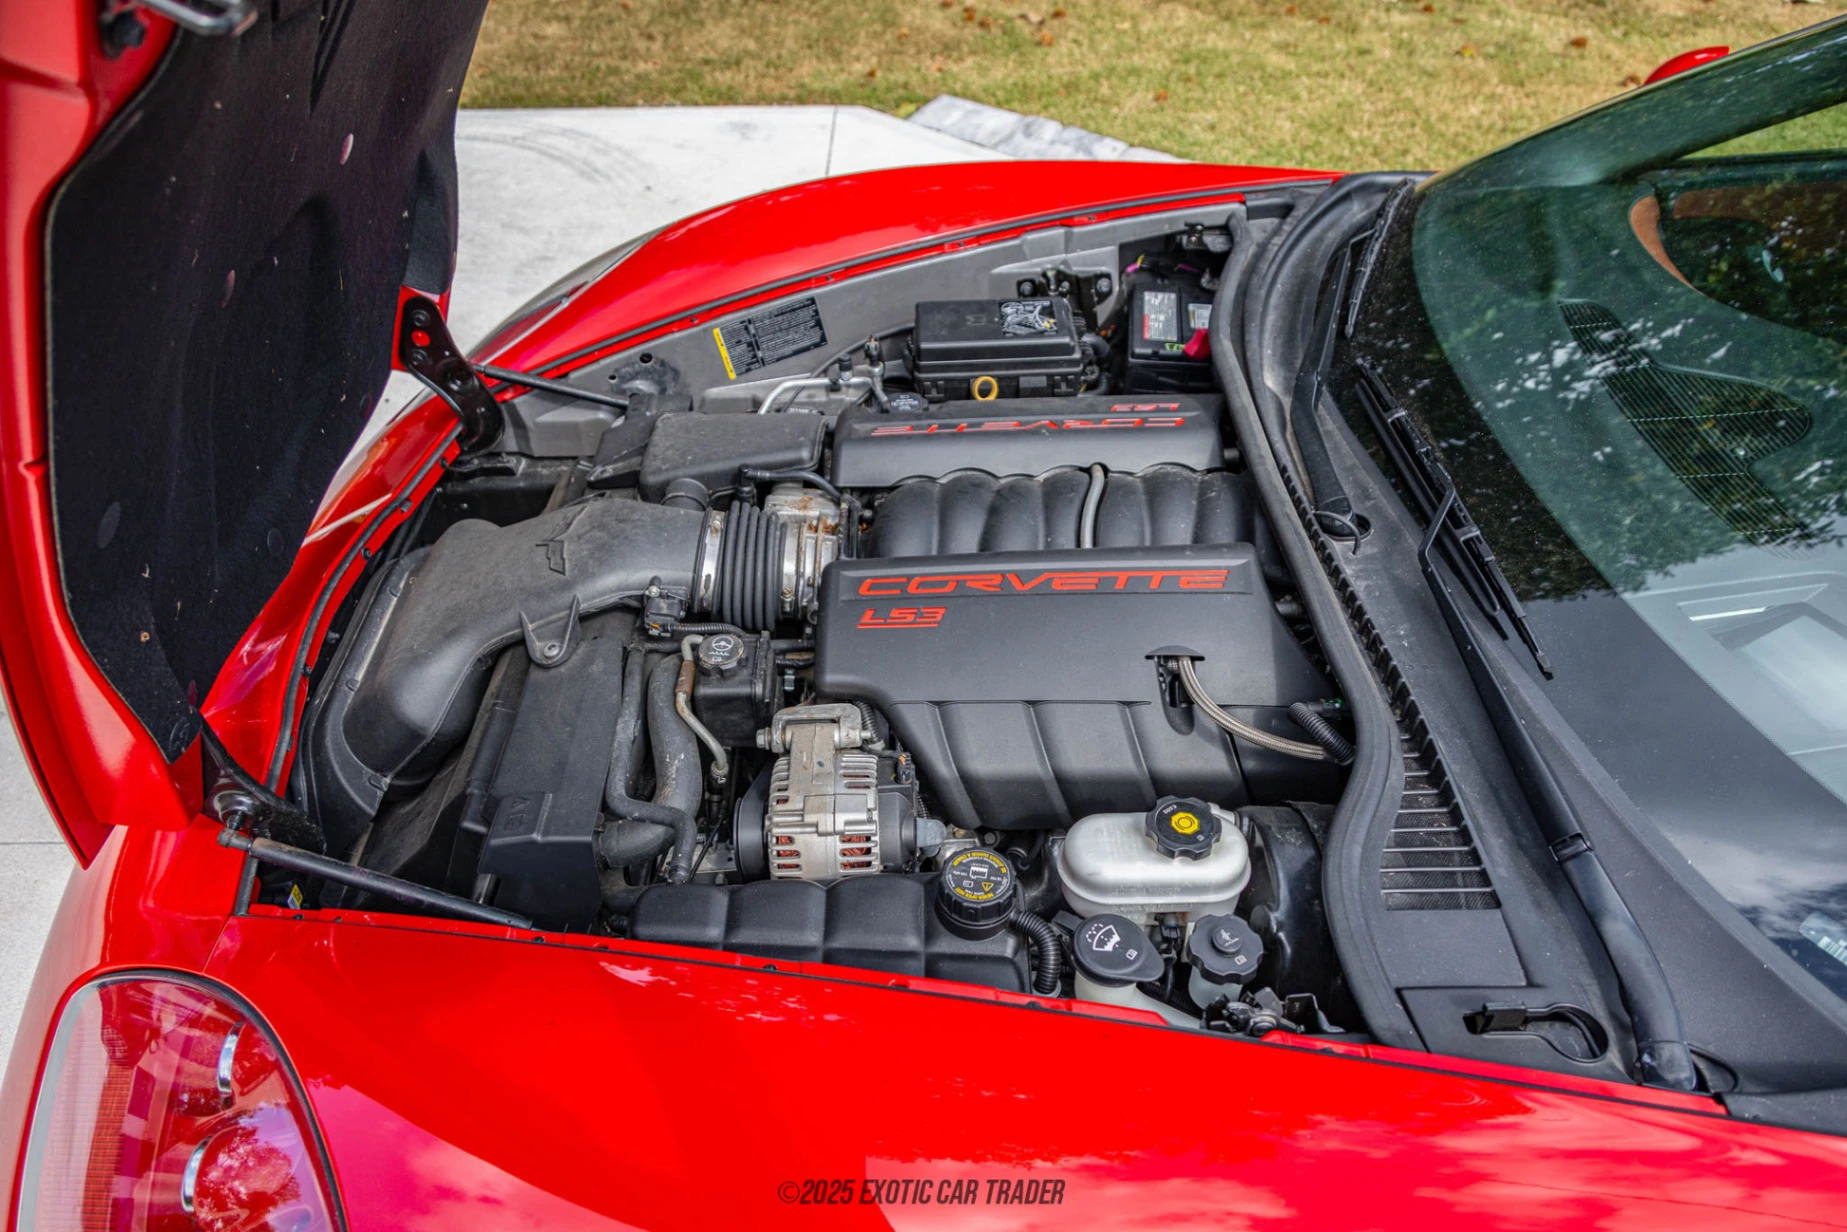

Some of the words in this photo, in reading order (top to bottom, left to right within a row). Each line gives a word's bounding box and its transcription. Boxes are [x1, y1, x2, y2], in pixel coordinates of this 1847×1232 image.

[871, 416, 1185, 436] CORVETTE
[858, 569, 1230, 596] CORVETTE
[857, 606, 947, 627] LS3
